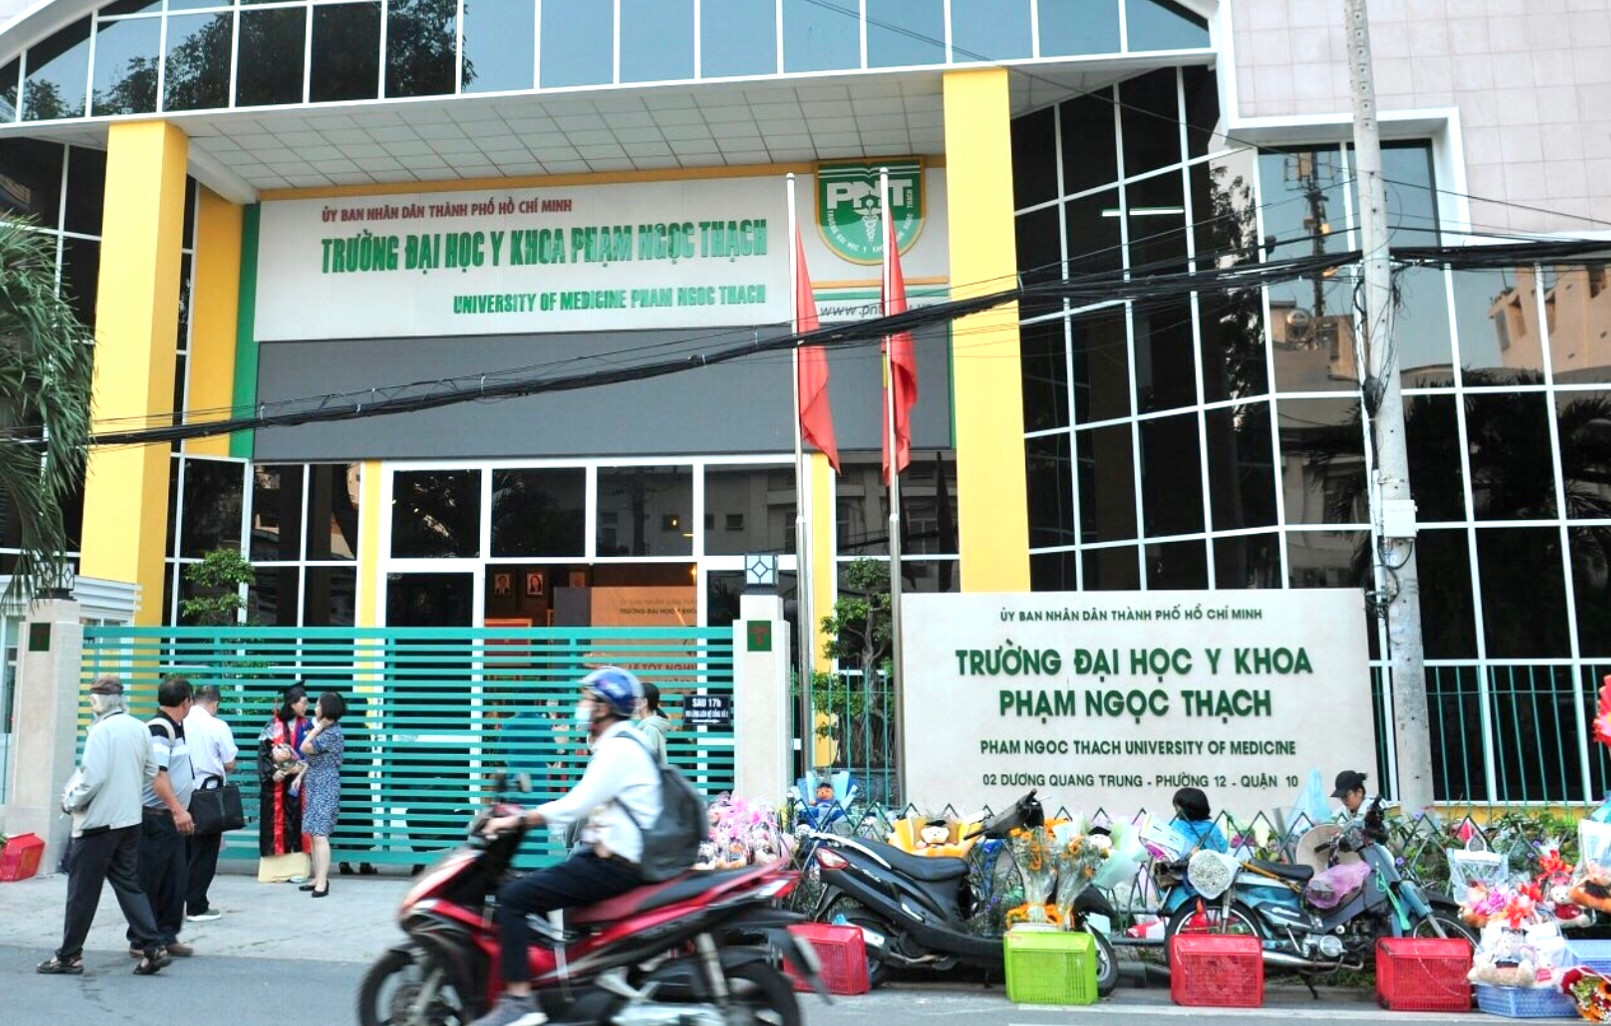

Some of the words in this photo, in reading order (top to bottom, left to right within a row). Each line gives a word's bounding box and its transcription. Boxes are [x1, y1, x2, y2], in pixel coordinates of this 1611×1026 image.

[322, 205, 338, 222] ỦY
[341, 208, 365, 221] BAN
[367, 204, 399, 220] NHÂN
[401, 203, 425, 219] DÂN
[429, 201, 468, 217] THÀNH
[471, 197, 495, 216] PHỐ
[499, 196, 516, 215] HỒ
[518, 197, 538, 213] CHÍ
[541, 199, 572, 213] MINH
[826, 178, 913, 210] PNT
[321, 228, 399, 273] TRƯỜNG
[405, 233, 441, 274] ĐẠI
[445, 231, 485, 273] HỌC
[490, 231, 504, 266] Y
[510, 228, 566, 266] KHOA
[571, 225, 632, 267] PHẠM
[638, 222, 695, 264] NGỌC
[699, 218, 767, 262] THẠCH
[453, 293, 537, 314] UNIVERSITY
[540, 292, 557, 311] OF
[560, 290, 627, 311] MEDICINE
[631, 287, 673, 308] PHAM
[677, 286, 716, 306] NGOC
[719, 284, 766, 305] THACH
[1000, 607, 1015, 621] ỦY
[1019, 611, 1042, 621] BAN
[1045, 607, 1080, 621] NHÂN
[1082, 607, 1108, 621] DÂN
[1111, 606, 1152, 621] THÀNH
[1155, 603, 1181, 620] PHỐ
[1184, 602, 1203, 620] HỒ
[1206, 604, 1229, 620] CHÍ
[1231, 608, 1263, 620] MINH
[955, 638, 1062, 676] TRƯỜNG
[1073, 648, 1119, 683] ĐẠI
[1130, 648, 1192, 683] HỌC
[1204, 648, 1222, 675] Y
[1234, 647, 1313, 675] KHOA
[999, 689, 1076, 724] PHẠM
[1085, 689, 1169, 724] NGỌC
[1181, 689, 1272, 724] THẠCH
[980, 740, 1021, 754] PHAM
[1024, 740, 1068, 755] NGOC
[1073, 740, 1122, 755] THACH
[1125, 740, 1203, 755] UNIVERSITY
[1207, 741, 1226, 755] OF
[1230, 740, 1296, 755] MEDICINE
[982, 774, 997, 786] 02
[1000, 772, 1045, 787] DƯƠNG
[1049, 774, 1095, 787] QUANG
[1099, 775, 1143, 787] TRUNG
[1156, 772, 1209, 788] PHƯỜNG
[1214, 775, 1227, 787] 12
[1241, 773, 1278, 790] QUẬN
[1286, 775, 1299, 787] 10
